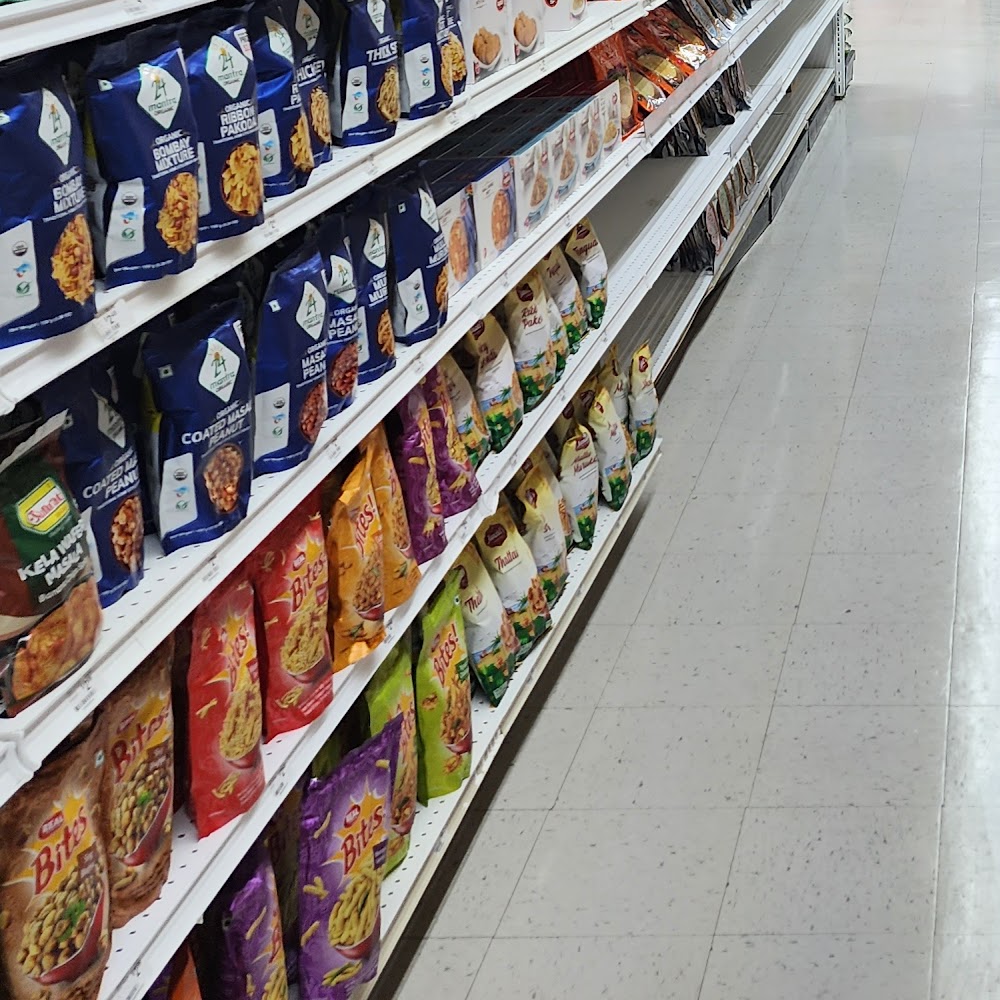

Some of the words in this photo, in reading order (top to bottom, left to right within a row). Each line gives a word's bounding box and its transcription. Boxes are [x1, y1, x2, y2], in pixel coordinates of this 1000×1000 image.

[219, 53, 234, 72] 24
[217, 68, 245, 83] mantra
[151, 80, 167, 101] 24
[148, 93, 177, 112] mantra
[224, 99, 252, 114] ORGANIC
[220, 104, 256, 127] RIBBON
[154, 129, 183, 146] ORGANIC
[220, 118, 259, 140] PAKODA
[152, 137, 191, 161] BOMBAY
[155, 147, 196, 173] MIXTURE
[329, 313, 358, 330] MASA
[332, 306, 358, 317] ORGAN
[522, 315, 543, 329] Pako
[329, 325, 358, 341] PEAN
[211, 354, 228, 379] 24
[302, 349, 327, 370] MASA
[303, 360, 327, 380] PEAN
[210, 369, 238, 390] mantra
[181, 413, 228, 446] COATED
[227, 402, 252, 427] MASA
[208, 418, 246, 447] PEANUT
[83, 465, 122, 500] COATED
[356, 495, 375, 556] ites!
[18, 550, 60, 582] KELA
[45, 542, 85, 586] MASALA
[290, 553, 327, 615] Bites
[432, 622, 458, 688] Bites!
[111, 710, 169, 783] Bites
[33, 805, 88, 895] Bites
[340, 807, 386, 876] Bites
